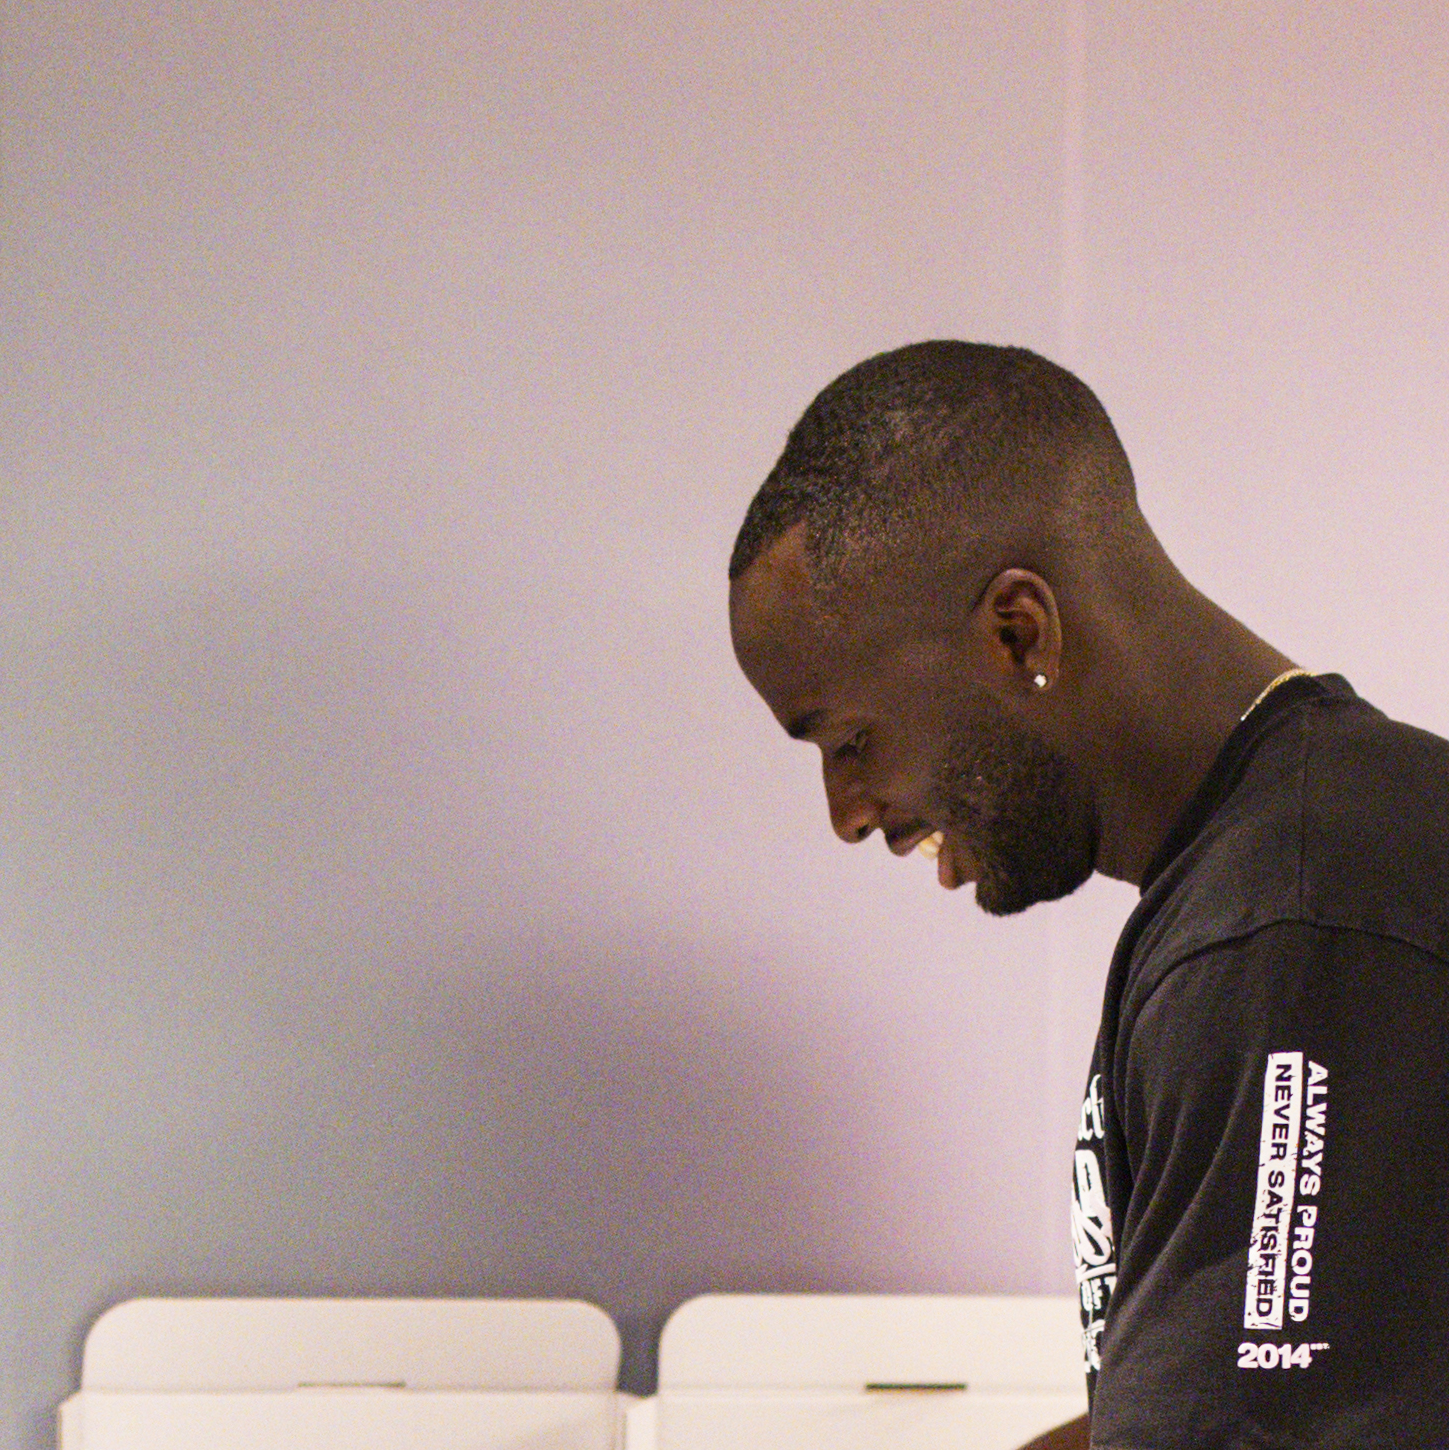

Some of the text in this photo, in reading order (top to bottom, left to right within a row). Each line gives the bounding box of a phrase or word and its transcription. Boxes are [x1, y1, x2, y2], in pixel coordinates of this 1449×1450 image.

[1255, 1063, 1293, 1318] NEVER SATISFIED
[1288, 1060, 1329, 1322] ALWAYS PROUD
[1237, 1342, 1313, 1369] 2014
